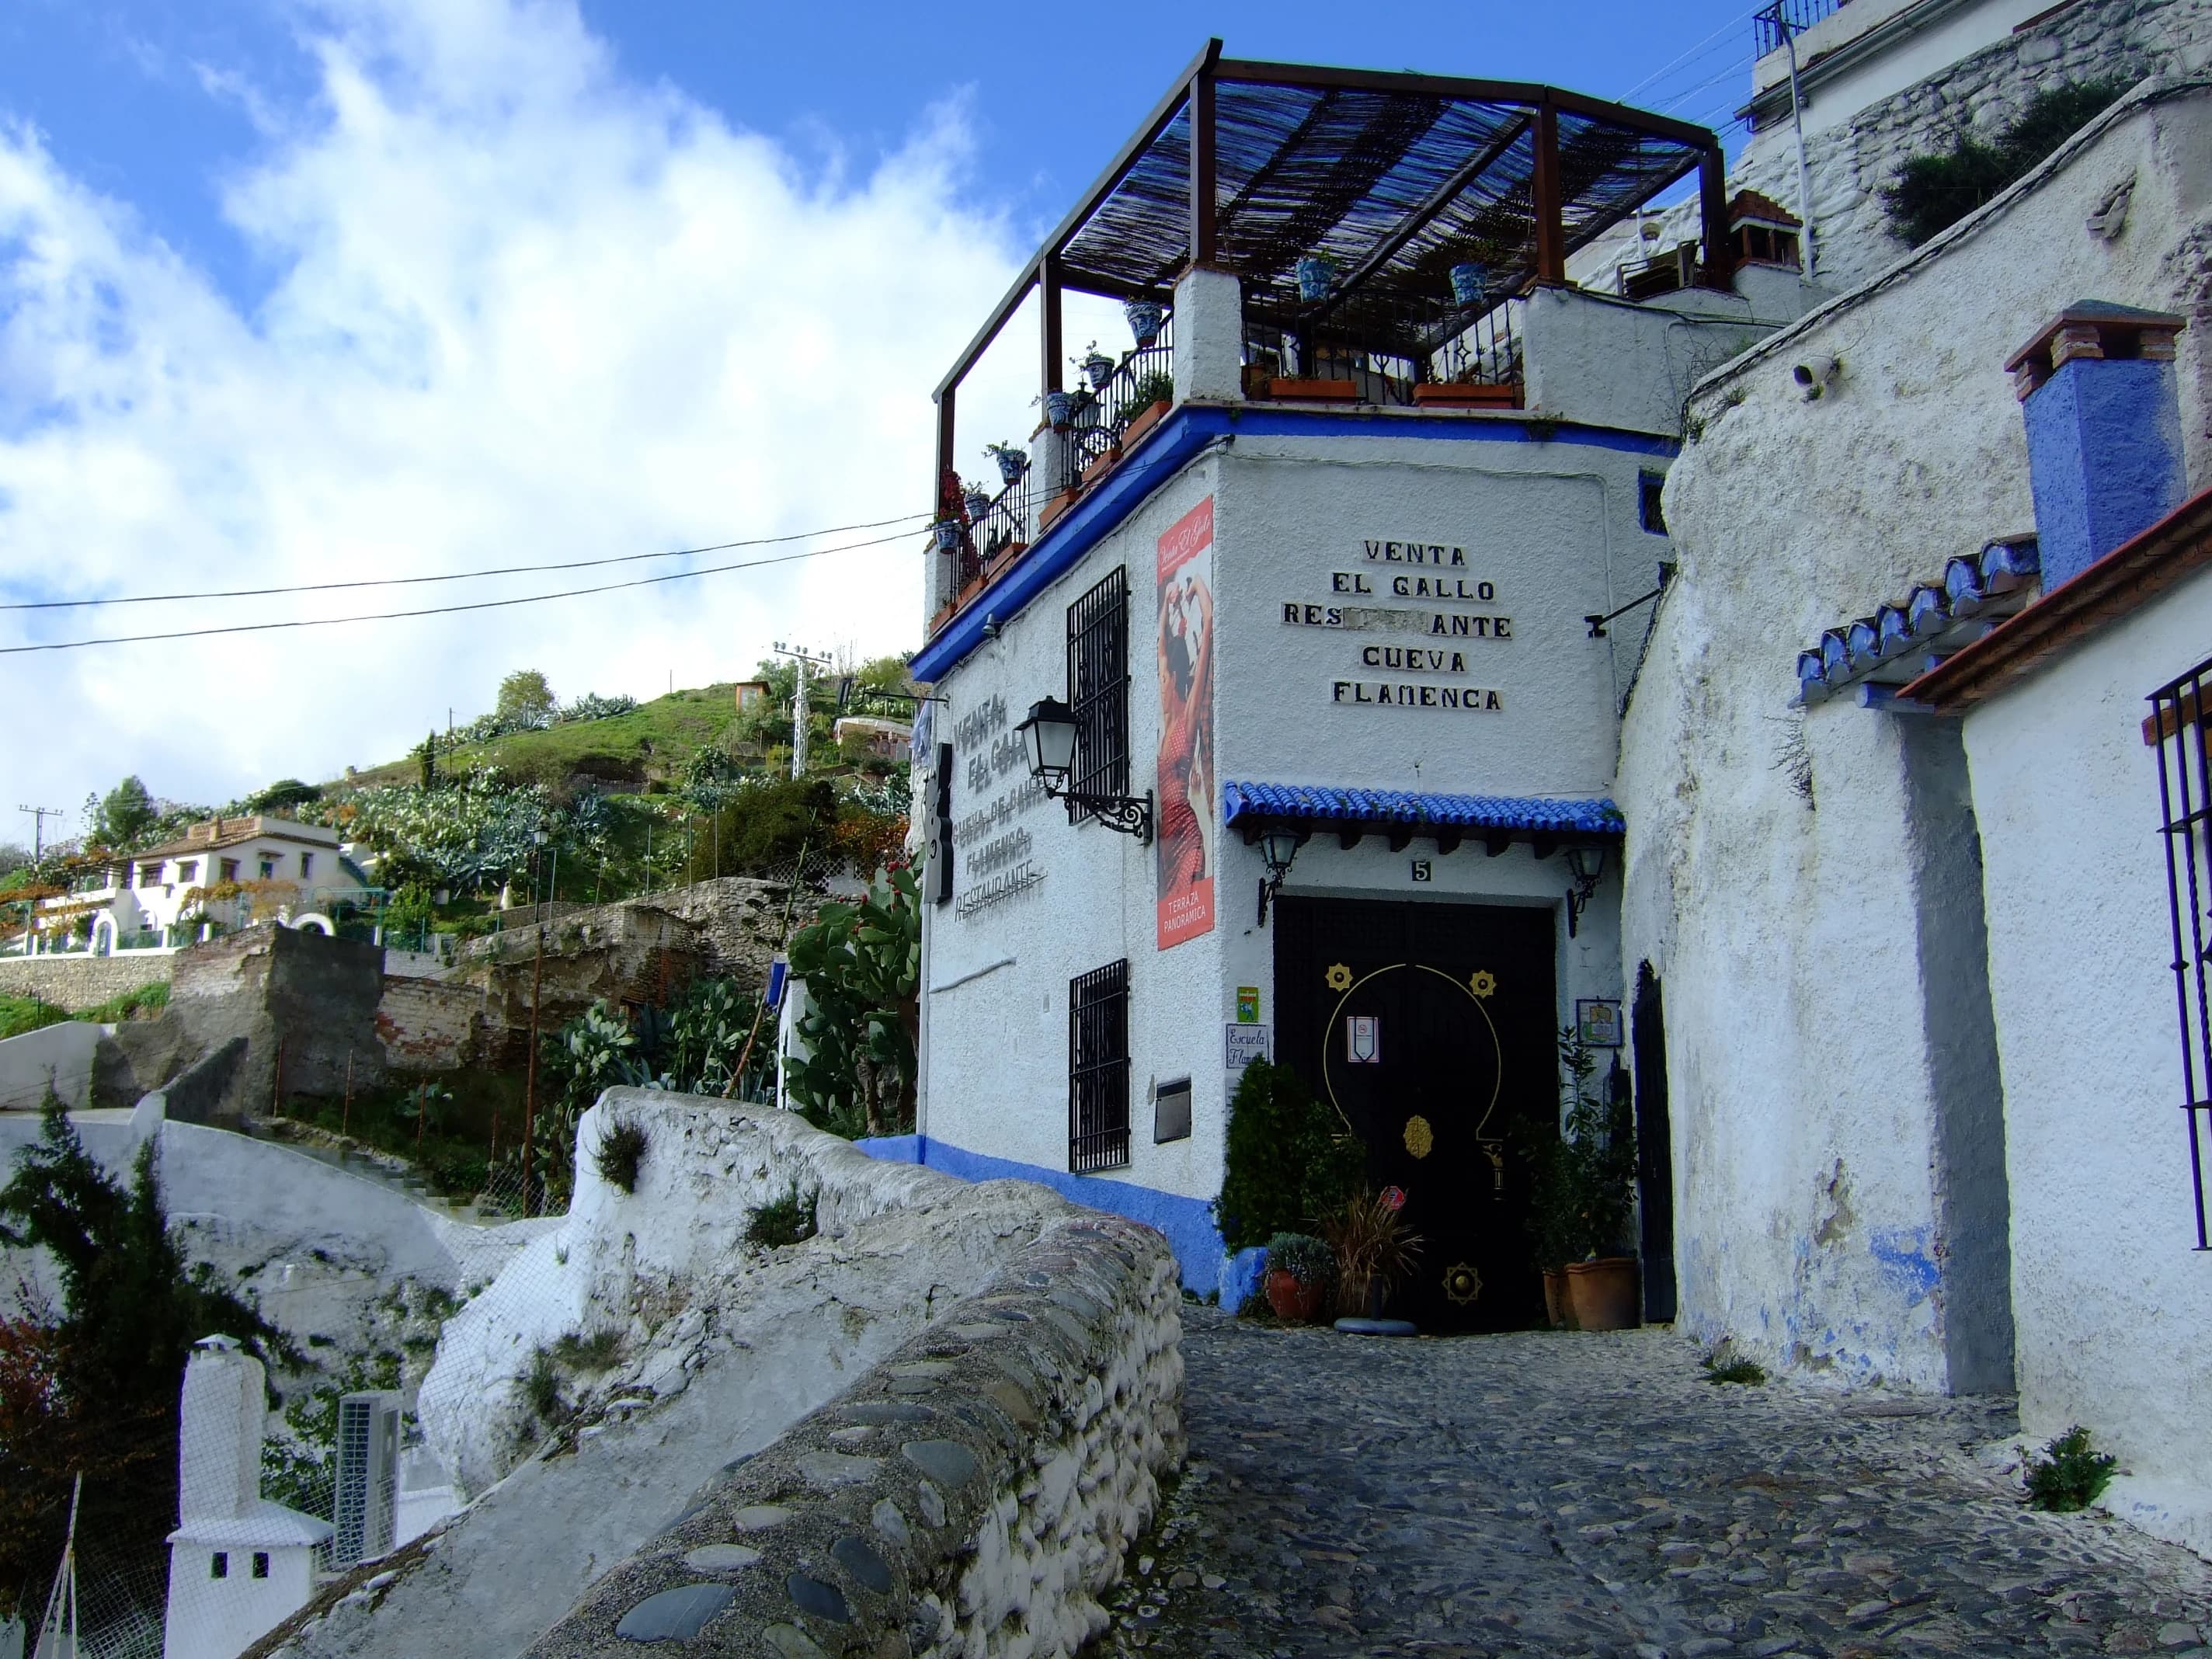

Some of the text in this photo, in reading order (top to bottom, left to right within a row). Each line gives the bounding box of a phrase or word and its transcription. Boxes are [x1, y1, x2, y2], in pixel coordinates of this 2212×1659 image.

[1363, 540, 1466, 566] VENTA
[1332, 572, 1494, 600] EL GALLO
[1362, 645, 1466, 672] CUEVA
[1333, 681, 1501, 710] FLAMENCA
[954, 693, 1004, 755] VENTA
[968, 753, 987, 791] EL
[953, 809, 986, 846] CUEVA
[991, 796, 1006, 823] DE
[966, 826, 1026, 875] FLAMENCO
[1415, 861, 1428, 881] 5
[955, 859, 1032, 923] RESTAURANTE
[1168, 890, 1199, 915] TERRAZA
[1229, 1028, 1264, 1045] Escuela
